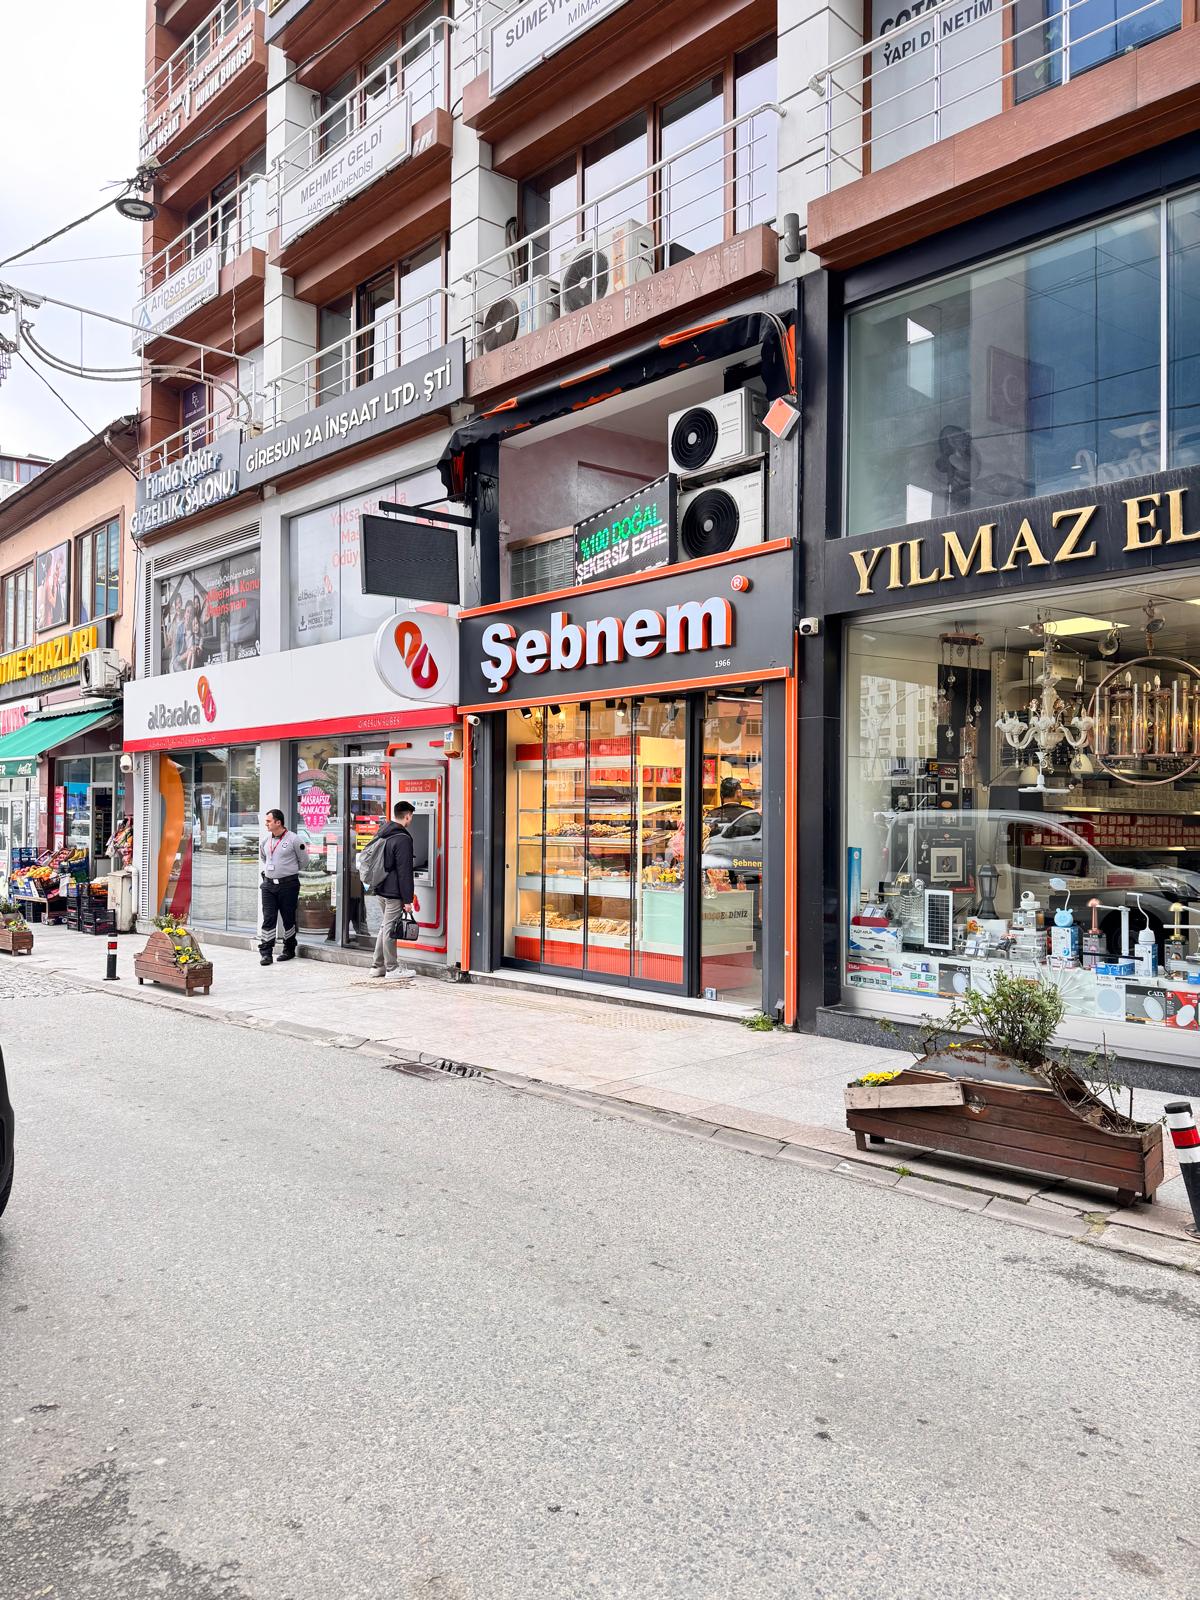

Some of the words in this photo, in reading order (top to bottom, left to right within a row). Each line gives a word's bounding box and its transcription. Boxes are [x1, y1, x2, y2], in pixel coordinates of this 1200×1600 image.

[568, 0, 601, 25] MİMA
[883, 37, 916, 66] YAPI
[920, 0, 993, 47] DNETİM
[196, 72, 220, 111] HUKUK
[220, 38, 253, 86] BÜROSU
[301, 157, 345, 204] MEHMET
[347, 125, 382, 167] GELDİ
[307, 190, 332, 215] HARİTA
[332, 155, 374, 198] MÜHENDİSİ
[187, 256, 213, 285] Grup
[246, 432, 301, 473] GİRESUN
[304, 422, 323, 449] 2A
[325, 396, 381, 439] İNŞAAT
[384, 381, 420, 415] LTD.
[423, 358, 451, 402] ŞTİ
[185, 468, 233, 514] SALONU
[330, 506, 361, 527] Yoksa
[362, 498, 379, 515] Siz
[576, 539, 630, 586] ŞEKERSİZ
[632, 523, 668, 557] EZME
[580, 527, 609, 561] %100
[612, 503, 663, 545] DOĞAL
[849, 505, 1098, 596] YILMAZ
[480, 596, 735, 694] Şebnem
[714, 659, 731, 668] 1966
[300, 805, 331, 815] BANKACILIK
[301, 795, 331, 805] MASRAFSIZ
